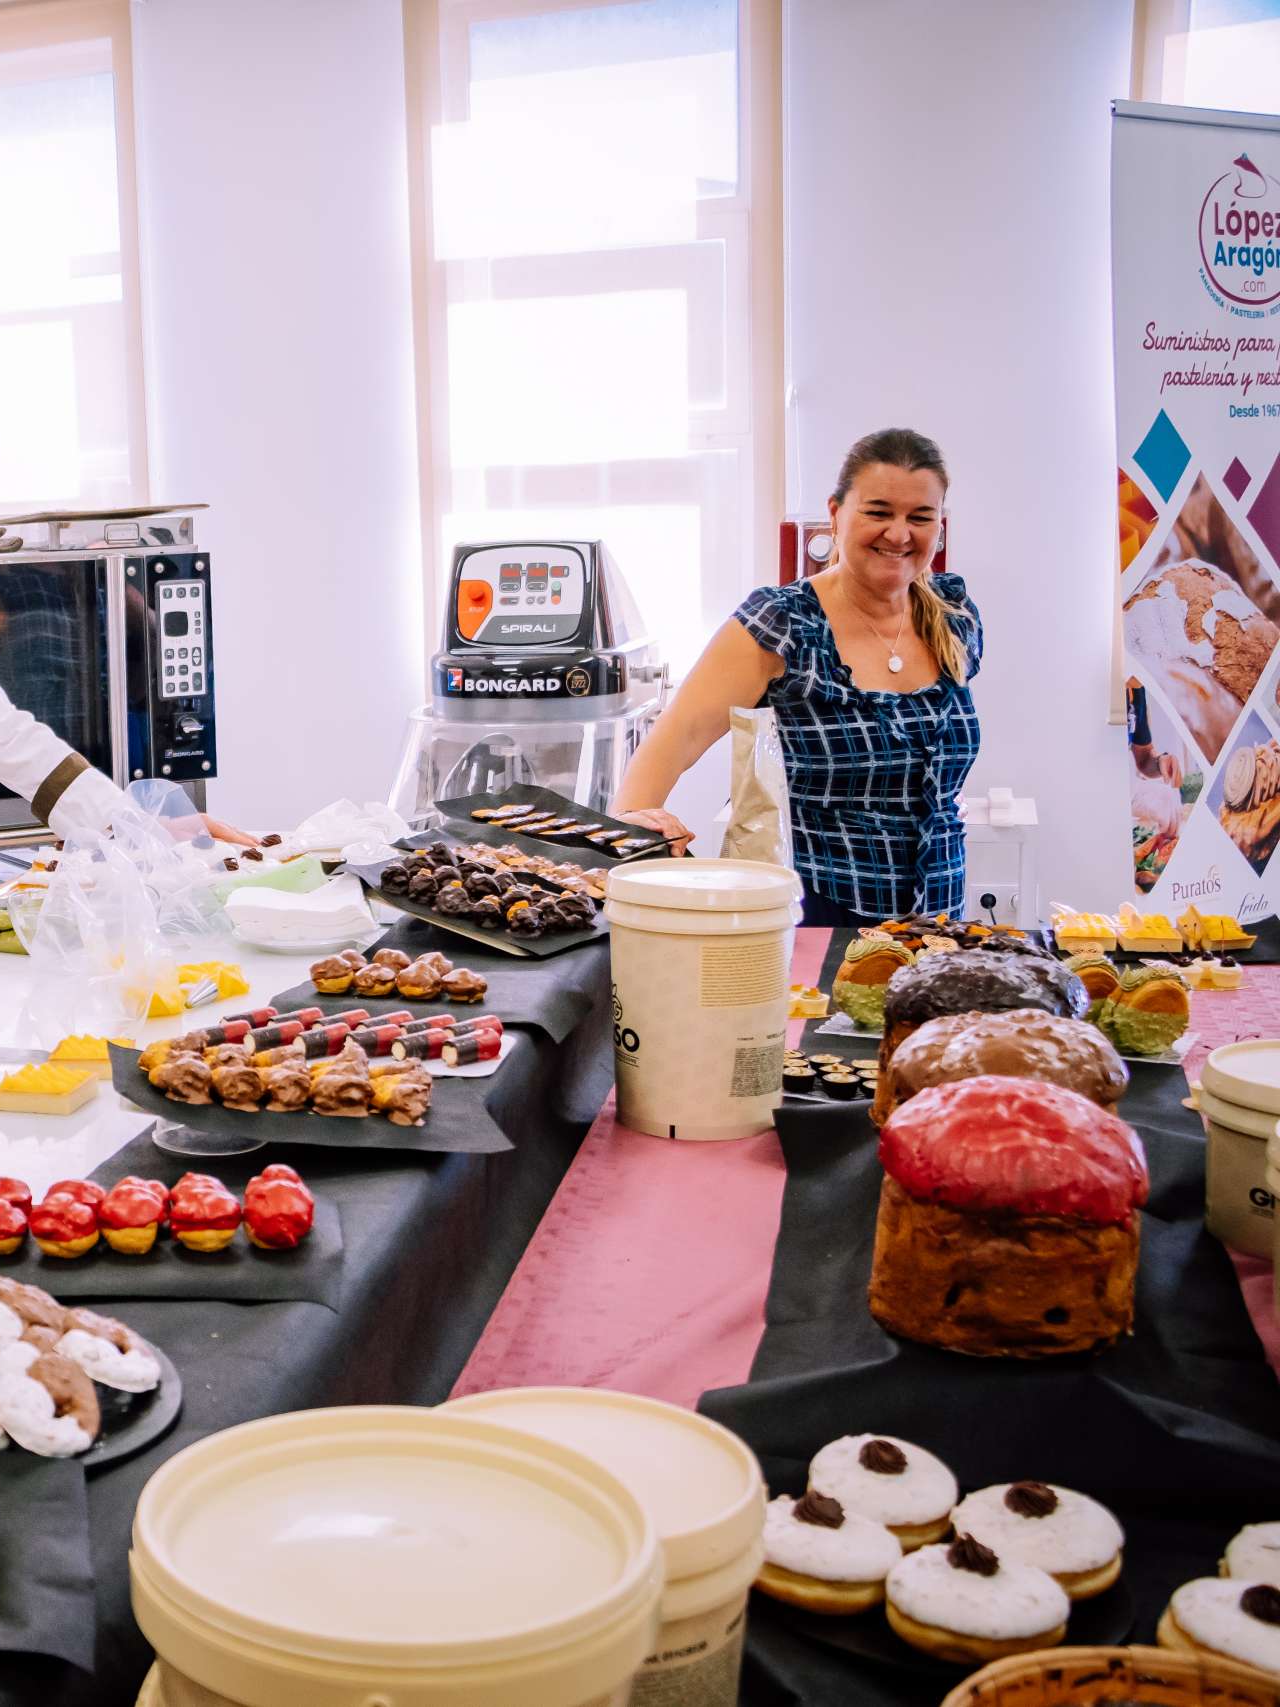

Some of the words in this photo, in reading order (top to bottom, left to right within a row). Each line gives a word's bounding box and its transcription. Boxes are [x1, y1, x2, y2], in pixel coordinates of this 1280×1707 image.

[1143, 321, 1231, 352] Suministros
[1233, 337, 1276, 361] para
[1160, 361, 1238, 395] pastelería
[1240, 372, 1253, 396] y
[1229, 404, 1259, 418] Desde
[464, 678, 561, 692] BONGARD
[1172, 878, 1222, 901] Puratos
